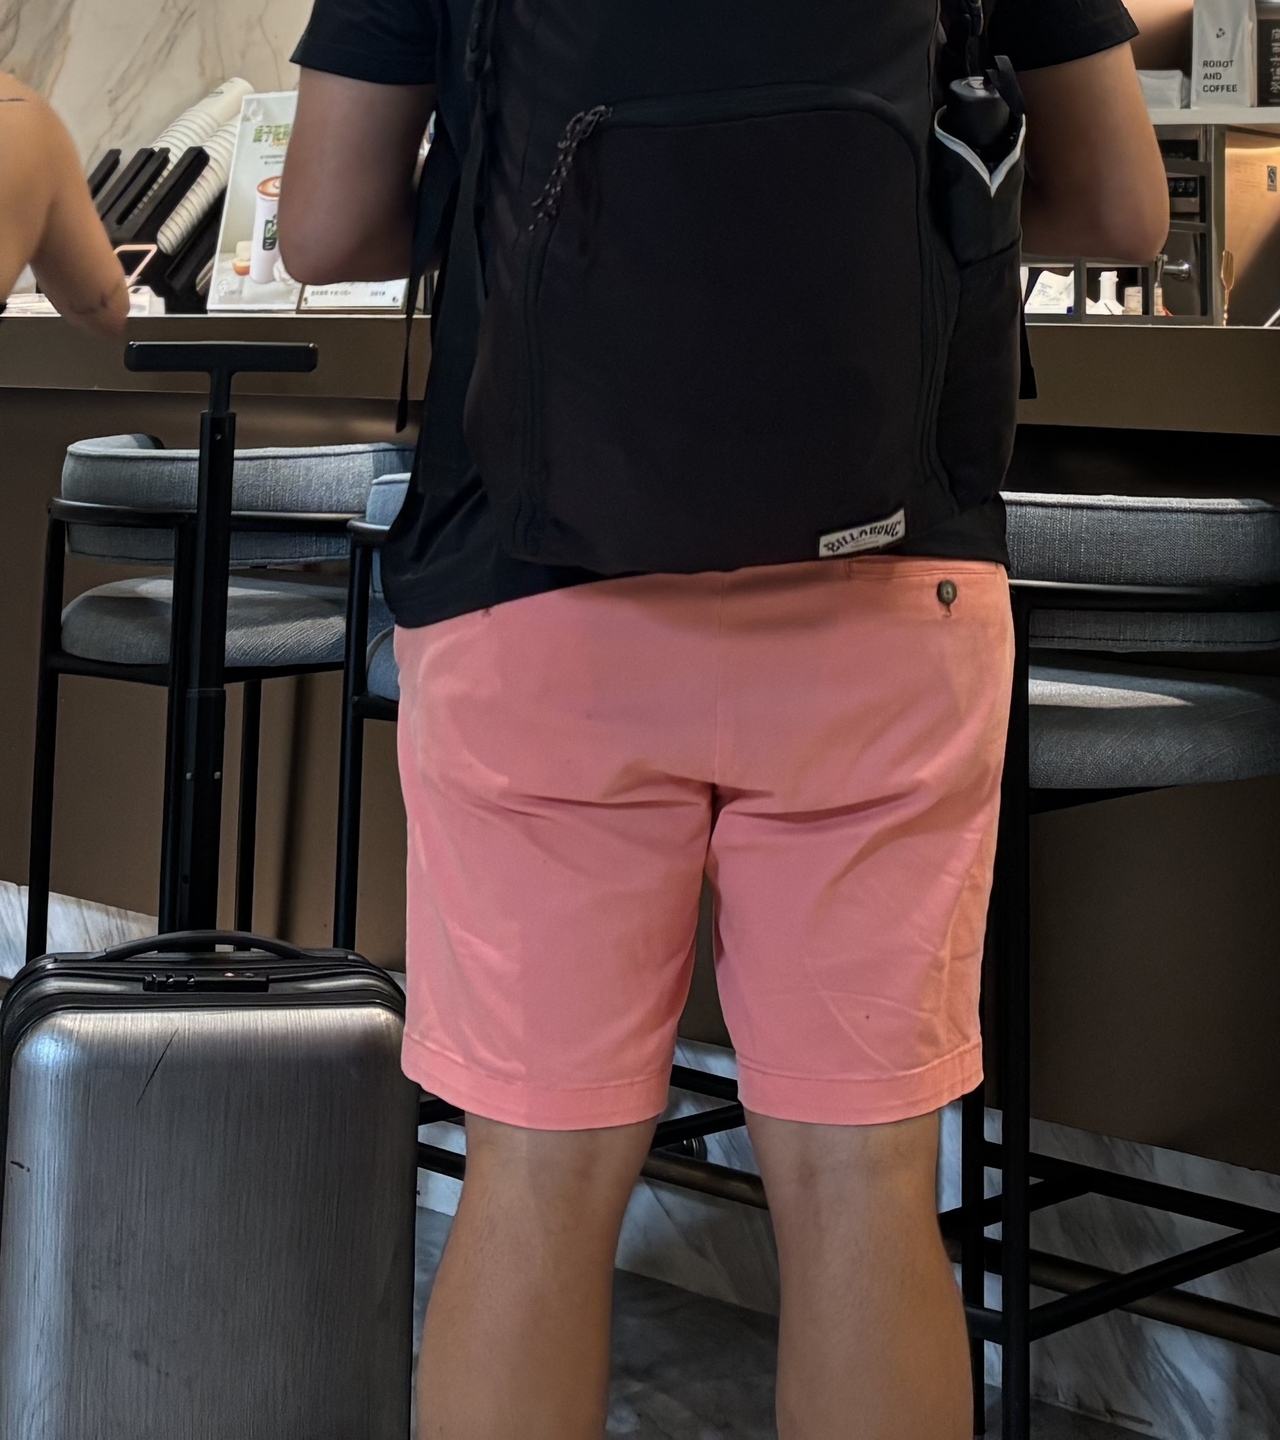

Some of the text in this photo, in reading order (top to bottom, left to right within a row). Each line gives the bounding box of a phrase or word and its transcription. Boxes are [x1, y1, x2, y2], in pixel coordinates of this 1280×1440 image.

[1203, 60, 1234, 68] ROBOT
[1203, 72, 1222, 80] AND
[1202, 84, 1237, 93] COFFEE
